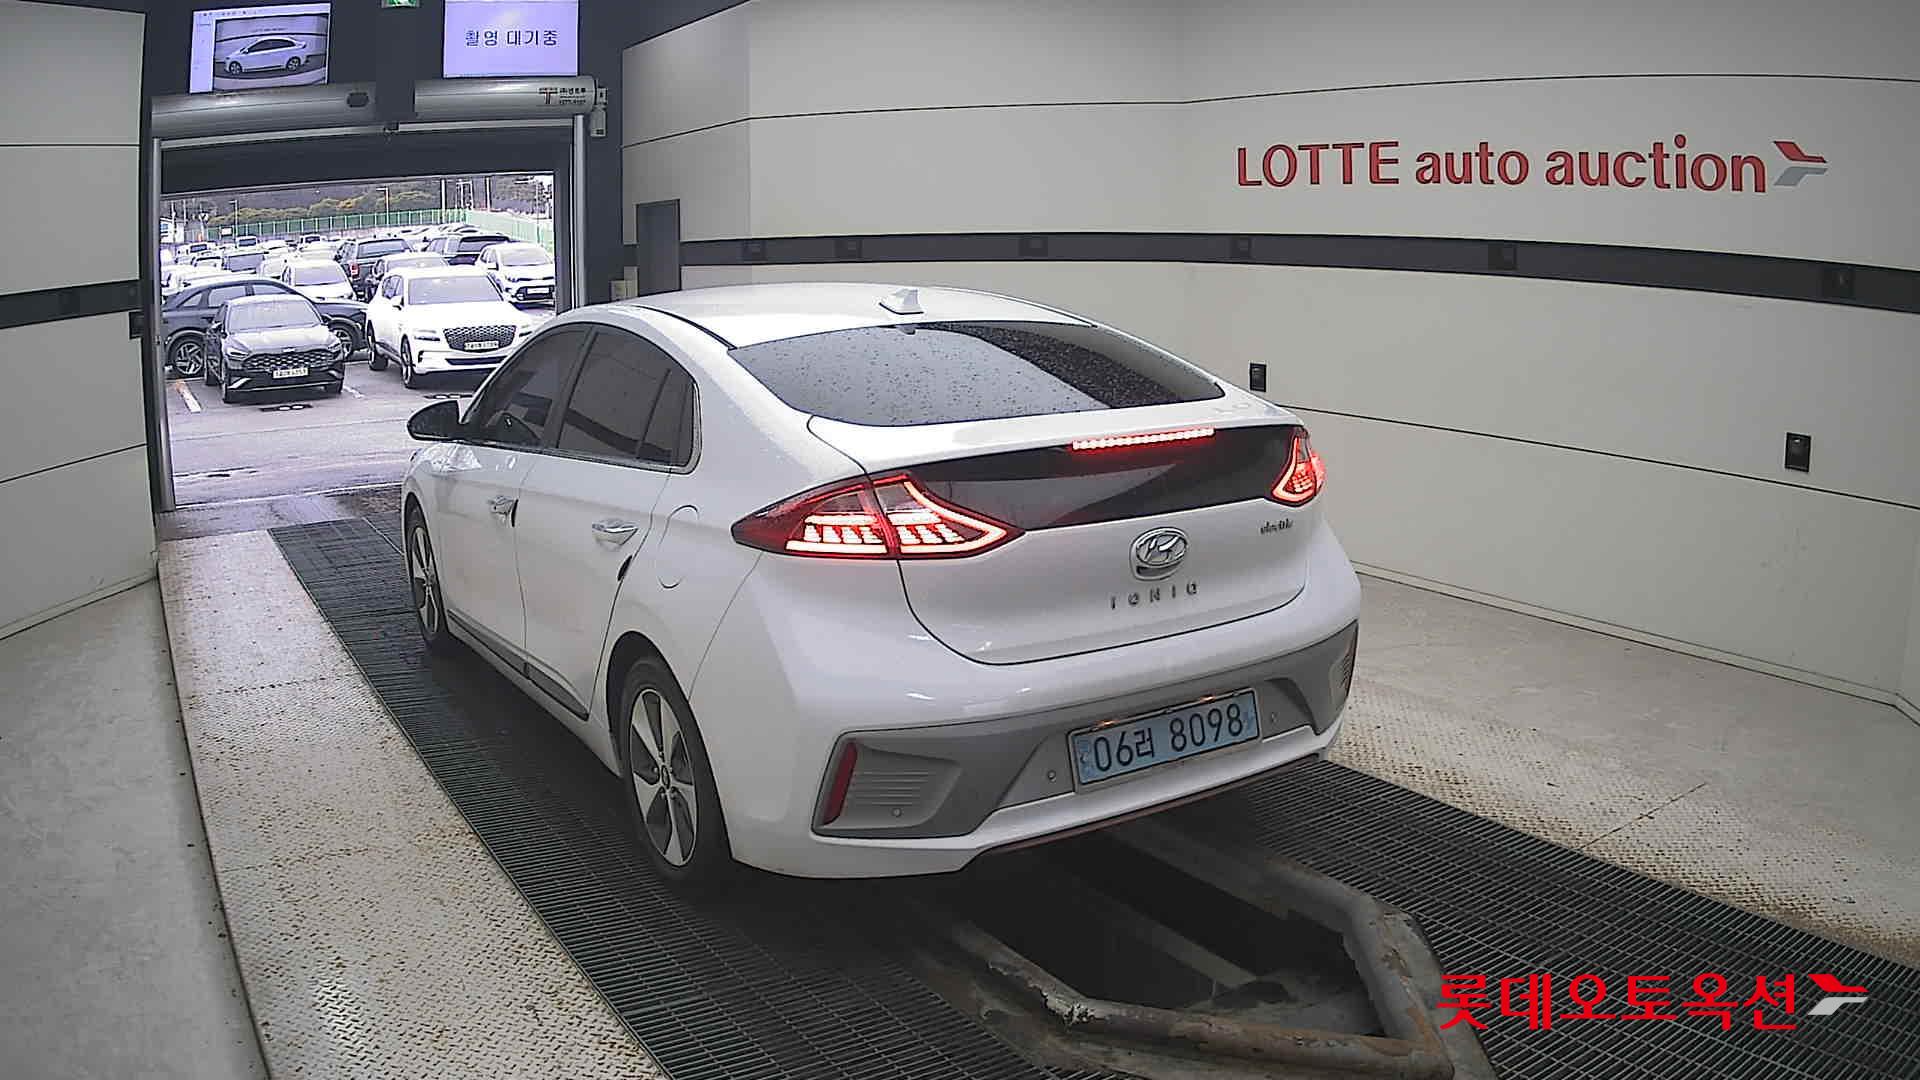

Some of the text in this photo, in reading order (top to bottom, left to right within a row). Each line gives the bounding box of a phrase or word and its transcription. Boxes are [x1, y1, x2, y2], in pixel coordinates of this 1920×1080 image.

[464, 29, 558, 47] 촬영 대기중
[1237, 134, 1767, 194] LOTTE auto auction
[1111, 580, 1198, 611] IONIQ
[1093, 702, 1244, 773] 06러 8098
